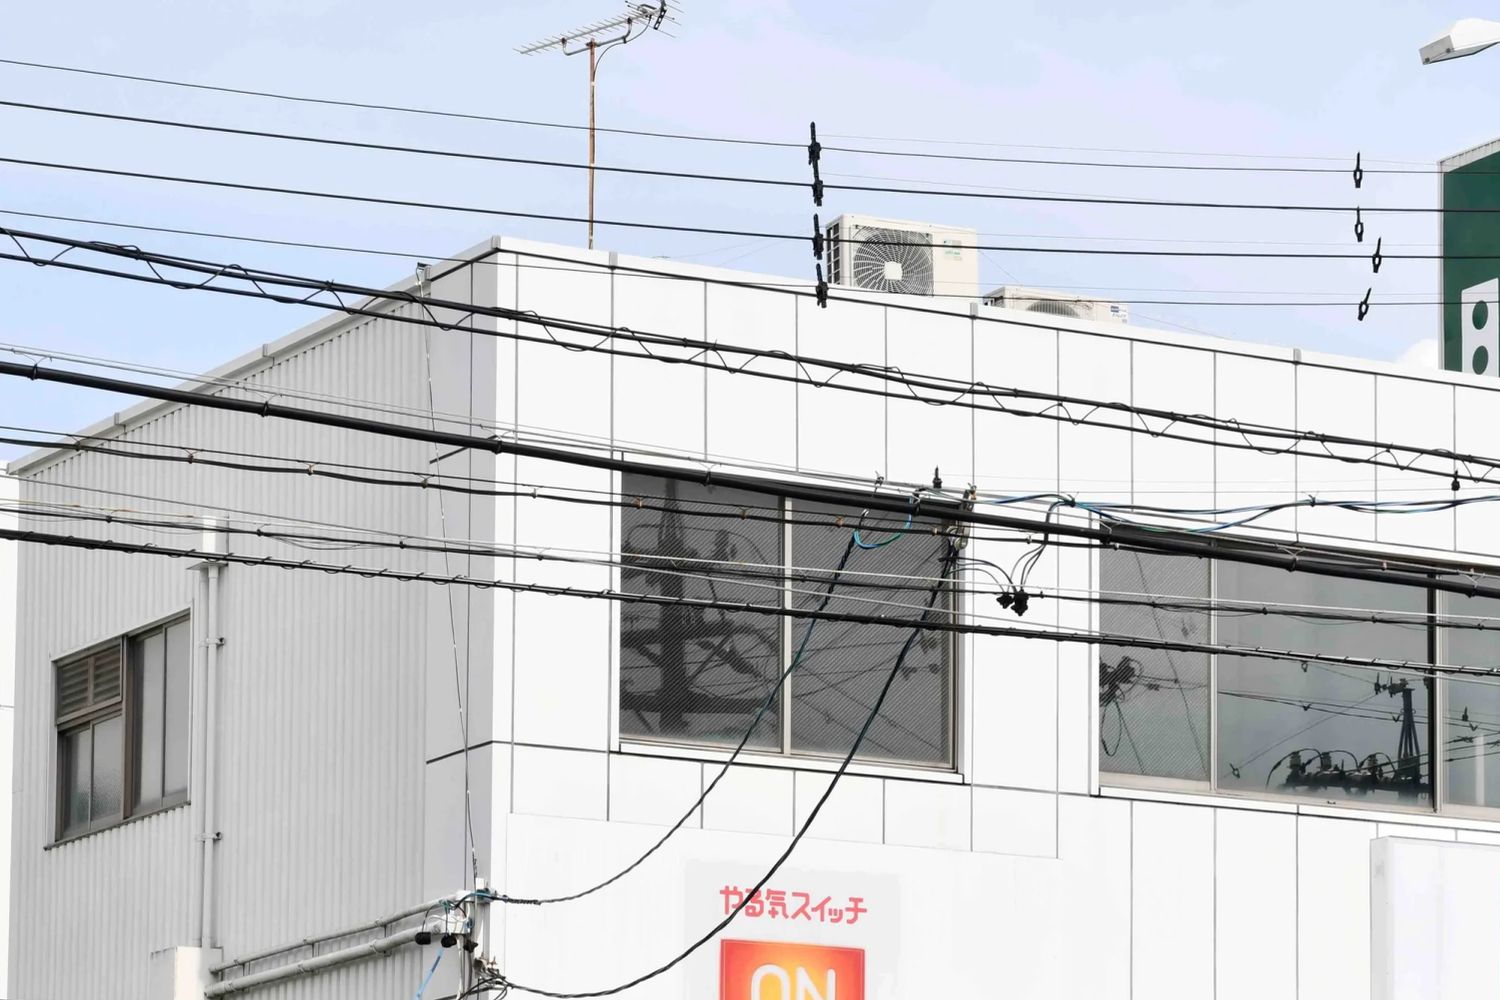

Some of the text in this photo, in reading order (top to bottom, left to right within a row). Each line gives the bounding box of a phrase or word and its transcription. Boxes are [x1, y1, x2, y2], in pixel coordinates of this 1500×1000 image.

[719, 886, 868, 925] やる気スイッチ
